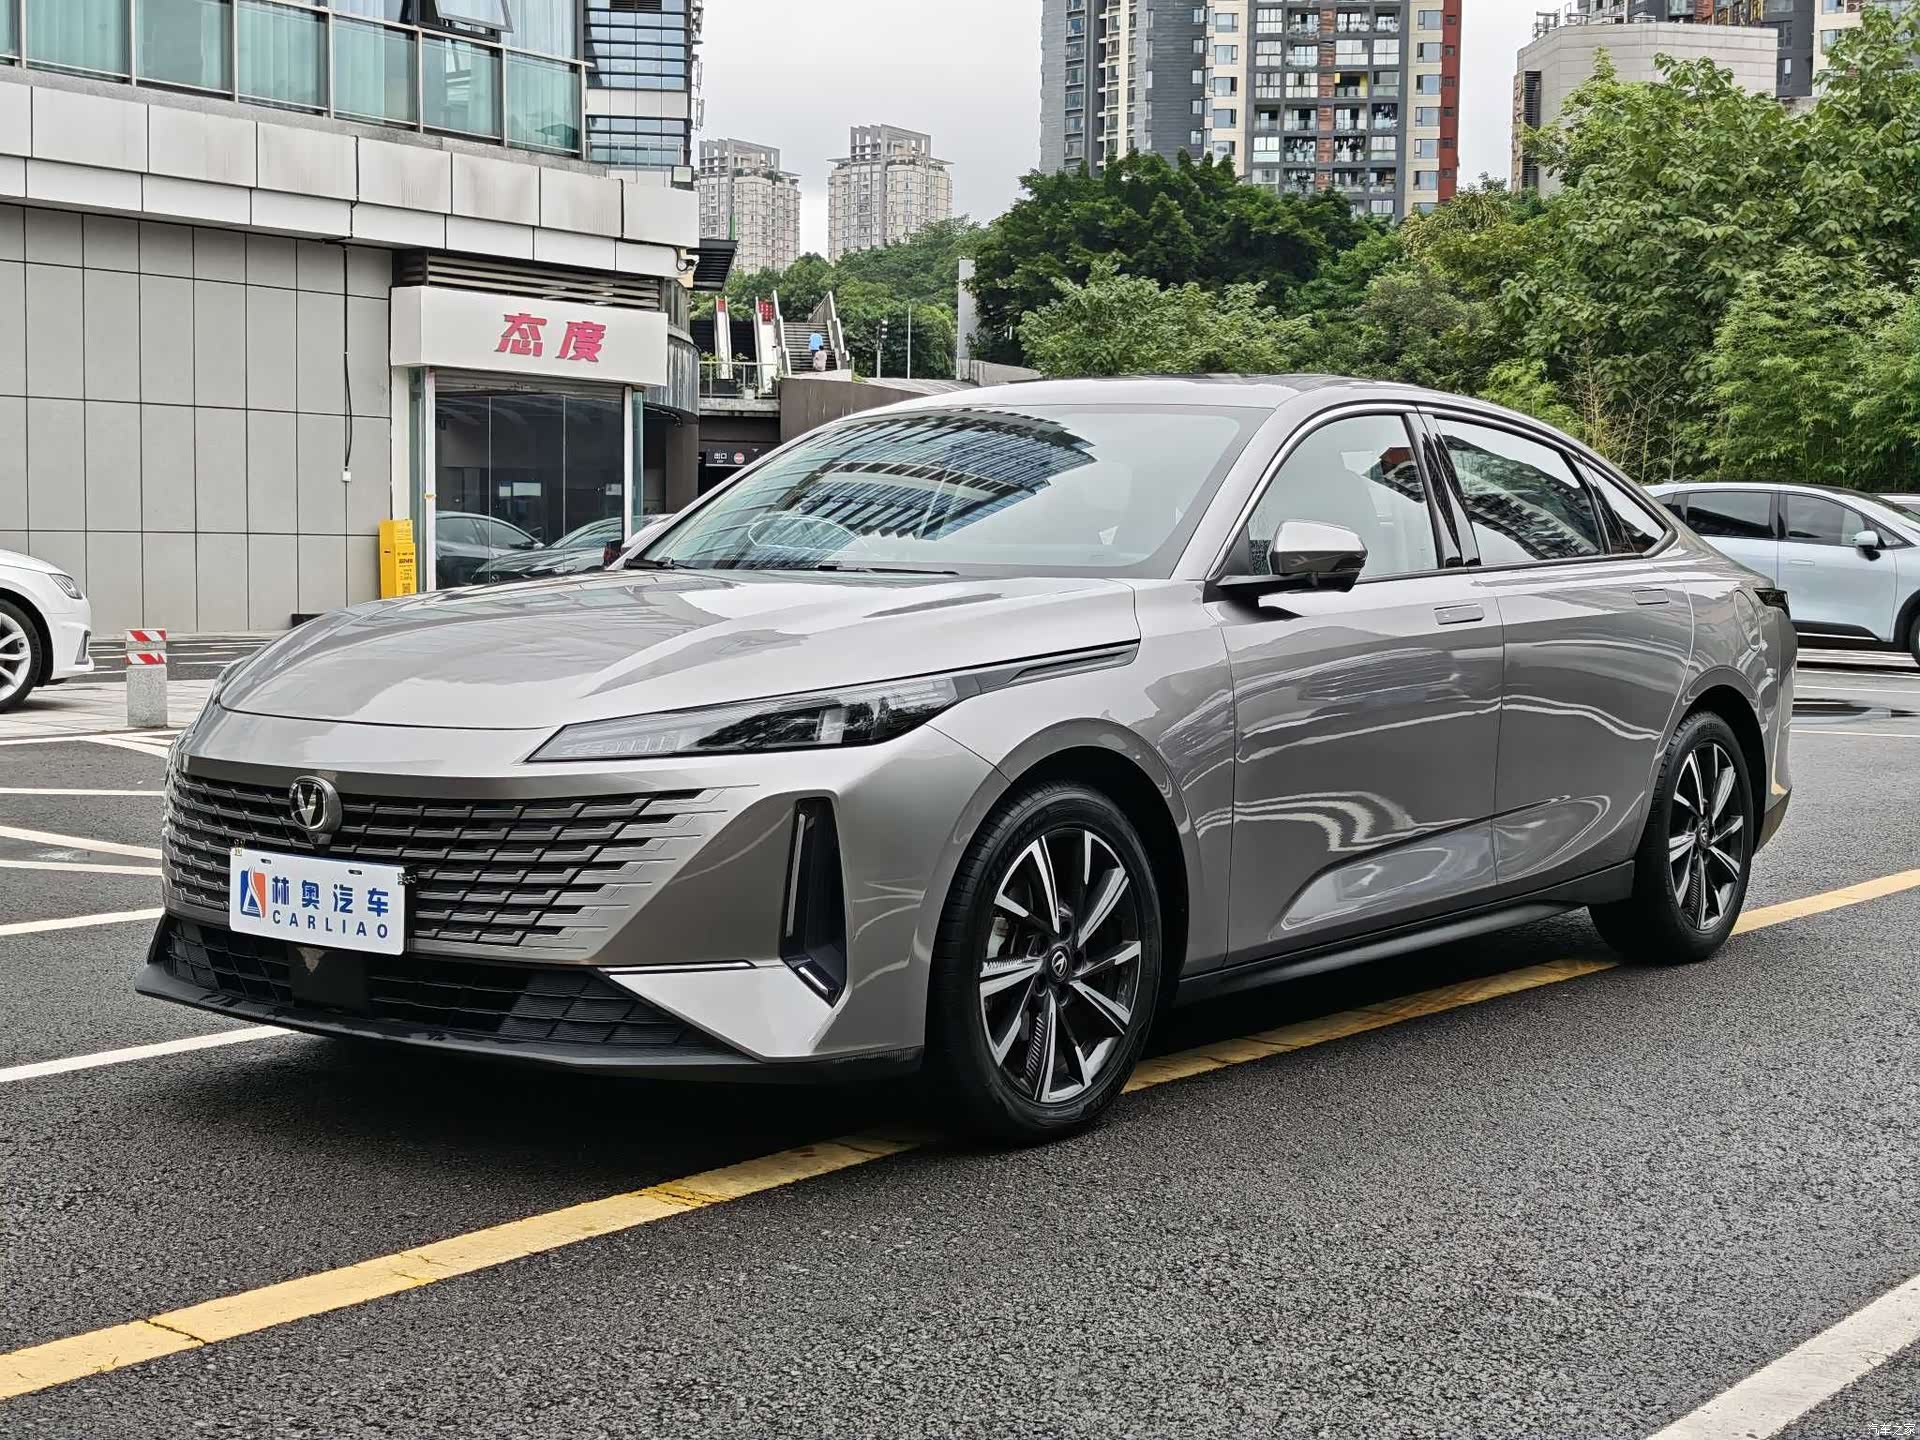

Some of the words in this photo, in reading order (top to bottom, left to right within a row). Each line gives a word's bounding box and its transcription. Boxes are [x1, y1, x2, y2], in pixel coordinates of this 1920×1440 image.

[494, 312, 607, 363] 态度
[272, 875, 389, 918] 林奥汽车
[272, 909, 388, 939] CARLIAO
